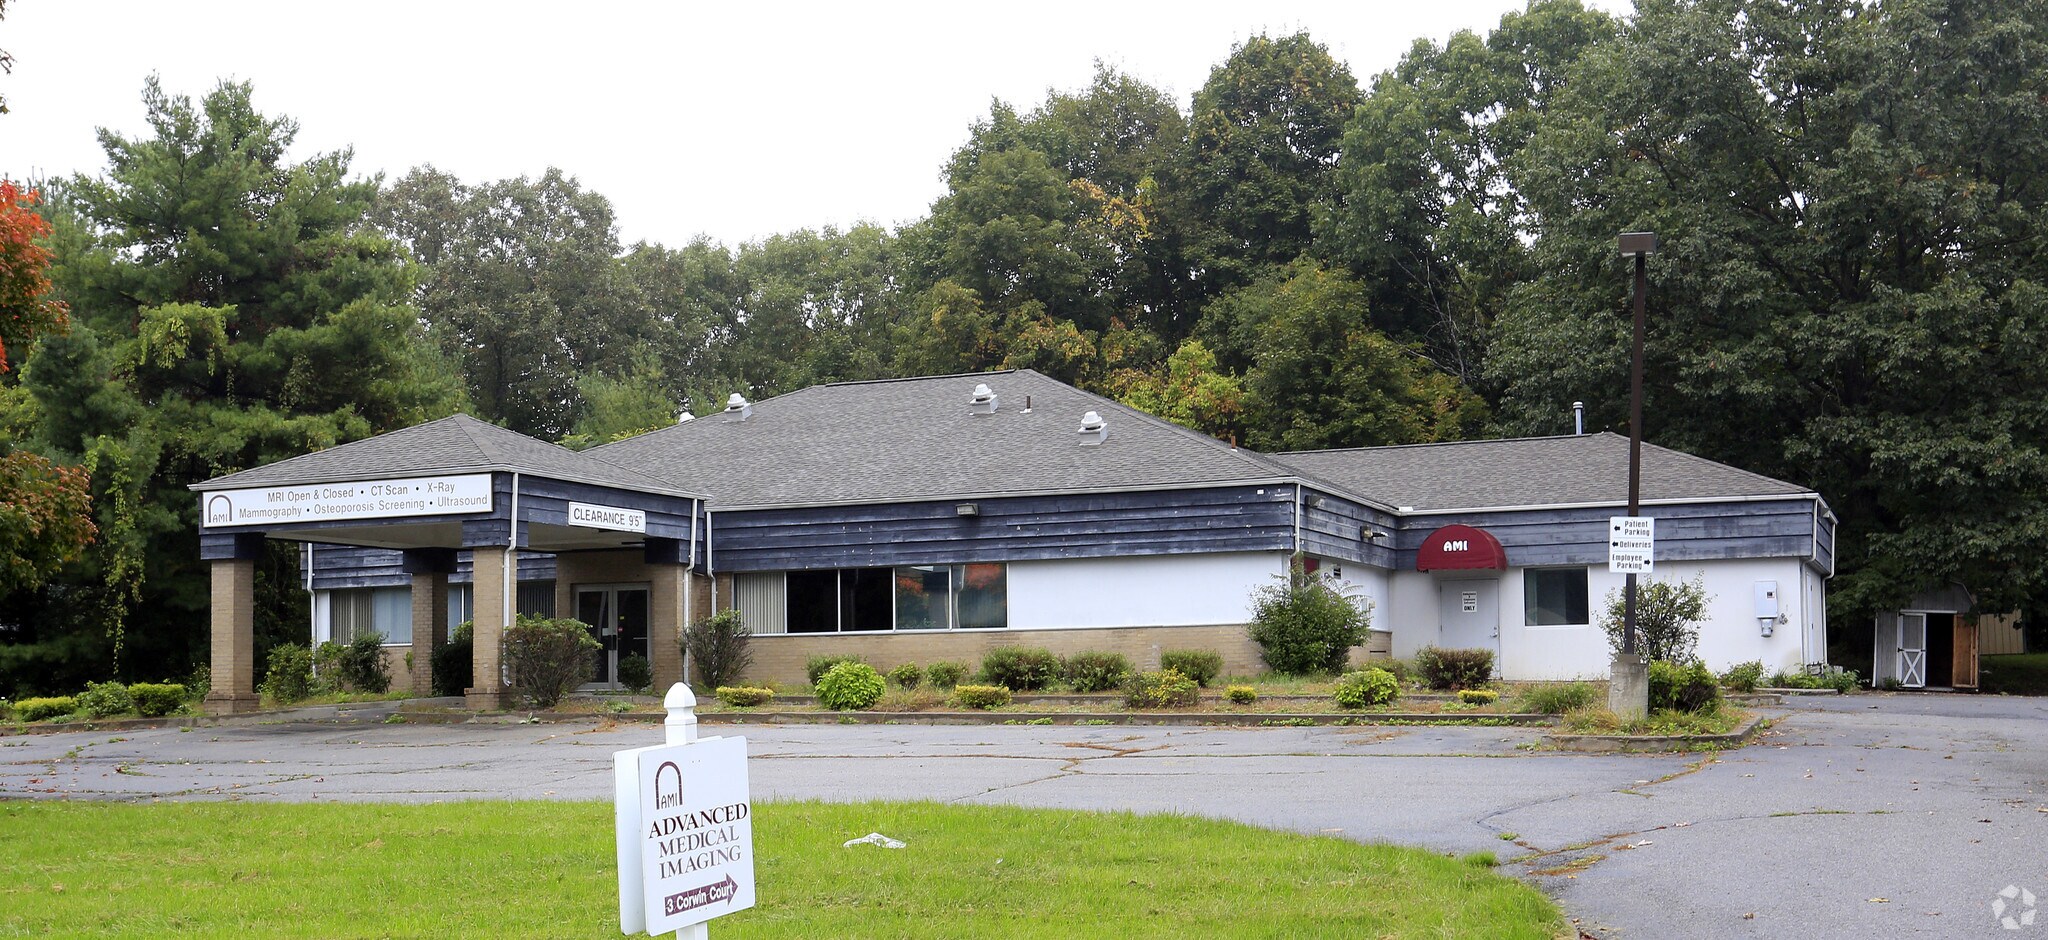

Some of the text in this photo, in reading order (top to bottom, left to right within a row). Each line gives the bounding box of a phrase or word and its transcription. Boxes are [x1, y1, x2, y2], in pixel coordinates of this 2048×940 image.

[267, 481, 455, 503] MRI Open & Closed CT Scan X-Ray
[239, 494, 488, 519] Mammography Osteoporosis Screening Ultrasound
[573, 508, 625, 525] CLEARANCE
[212, 513, 228, 523] AMI
[1443, 540, 1468, 552] AMI
[1612, 554, 1643, 562] Employee
[1616, 562, 1642, 570] Parking
[661, 792, 678, 810] AMI
[648, 802, 748, 839] ADVANCED
[658, 825, 740, 859] MEDICAL
[659, 845, 742, 880] IMAGING
[666, 881, 733, 913] 3 Corwin Court
